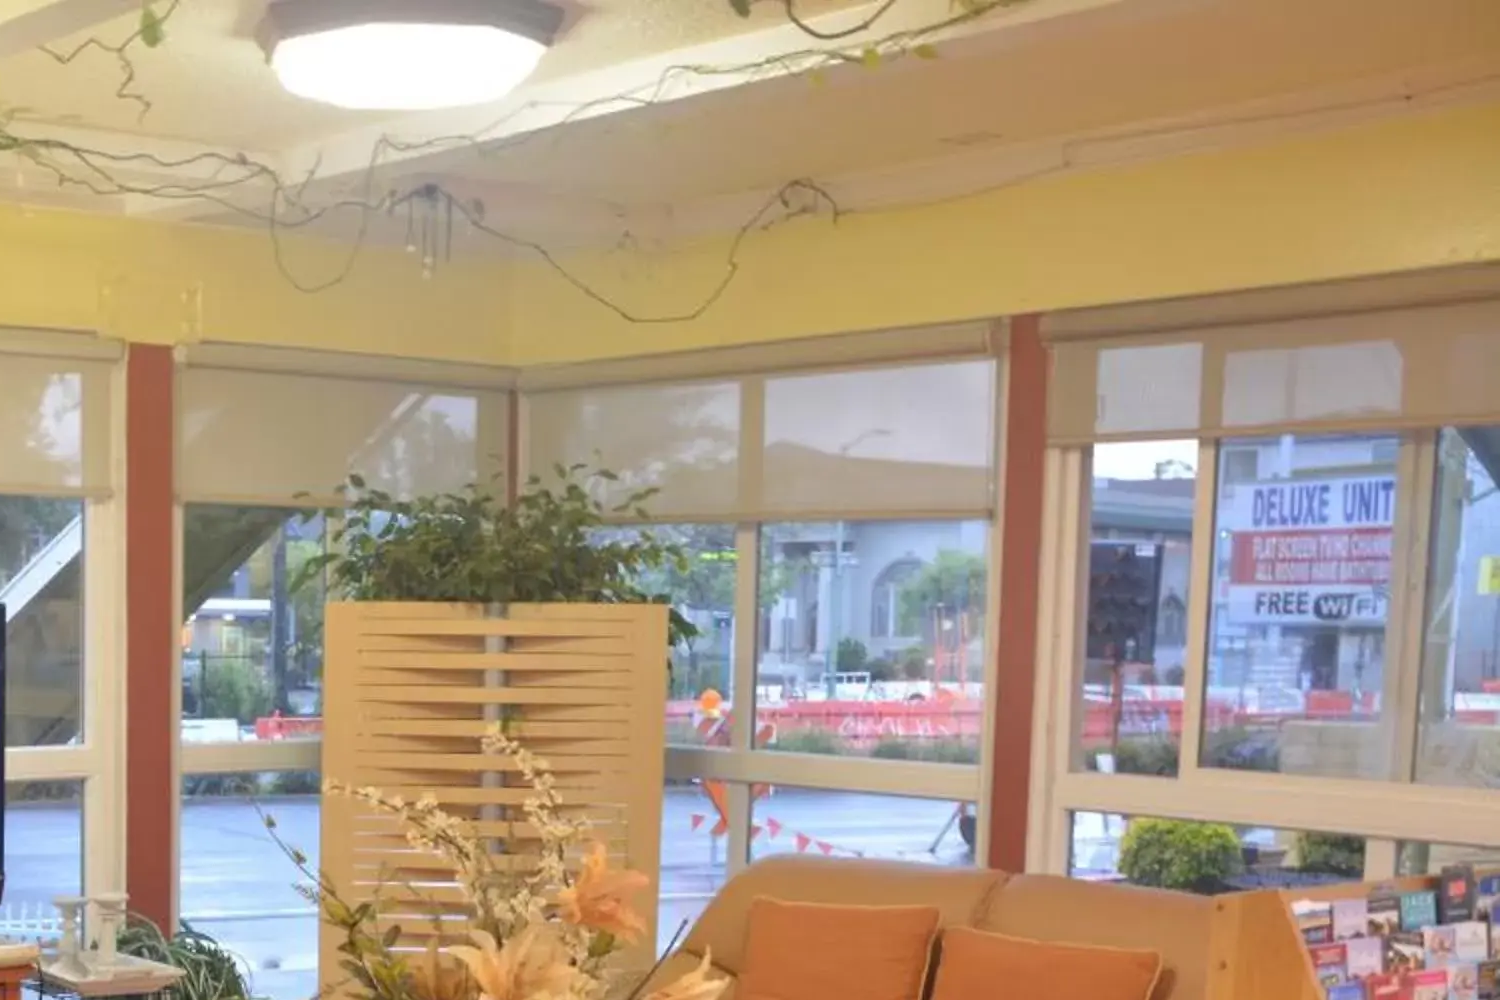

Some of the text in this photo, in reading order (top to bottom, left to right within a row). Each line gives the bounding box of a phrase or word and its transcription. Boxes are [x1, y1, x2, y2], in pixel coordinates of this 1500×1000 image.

[1252, 480, 1395, 527] DELUXE UNIT
[1254, 590, 1310, 616] FREE
